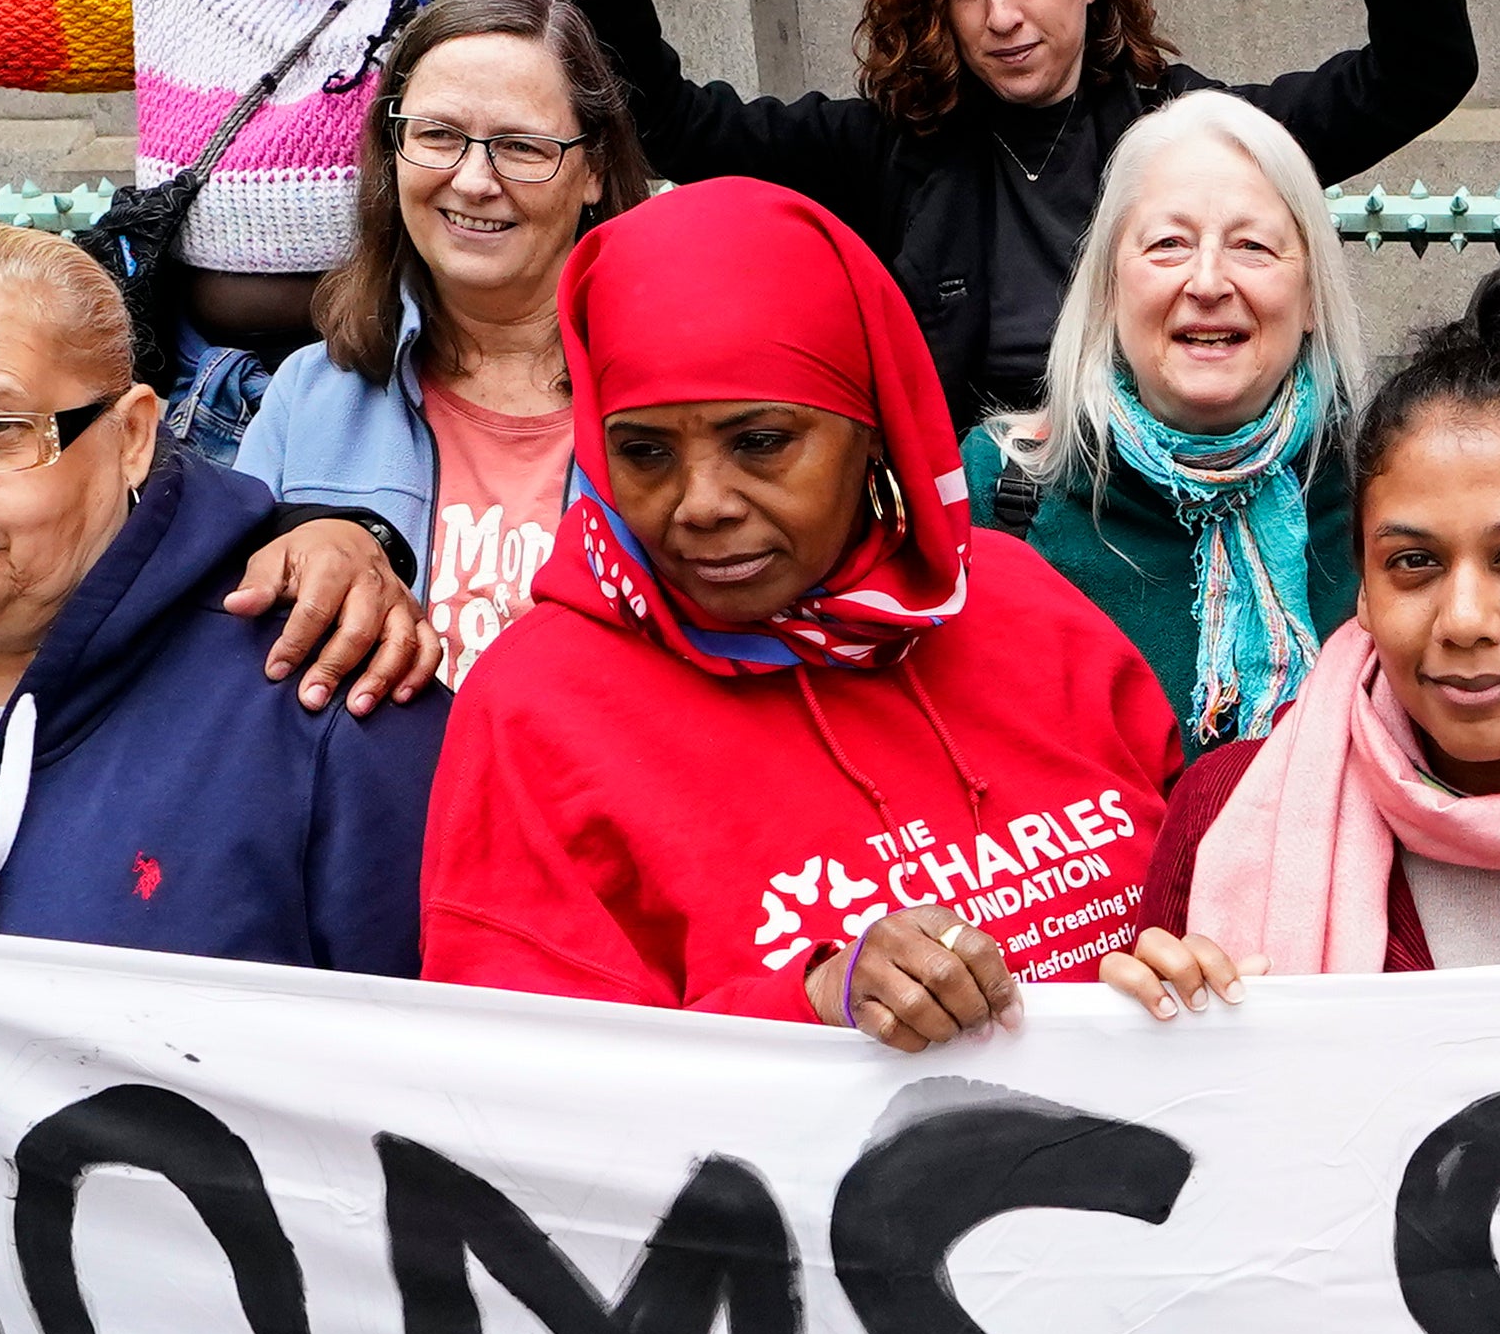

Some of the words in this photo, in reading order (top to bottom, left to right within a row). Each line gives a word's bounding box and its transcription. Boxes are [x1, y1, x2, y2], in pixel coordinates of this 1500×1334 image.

[865, 818, 936, 862] THE
[888, 789, 1136, 907] CHARLES
[1007, 923, 1041, 953] and
[1043, 894, 1127, 938] Creating
